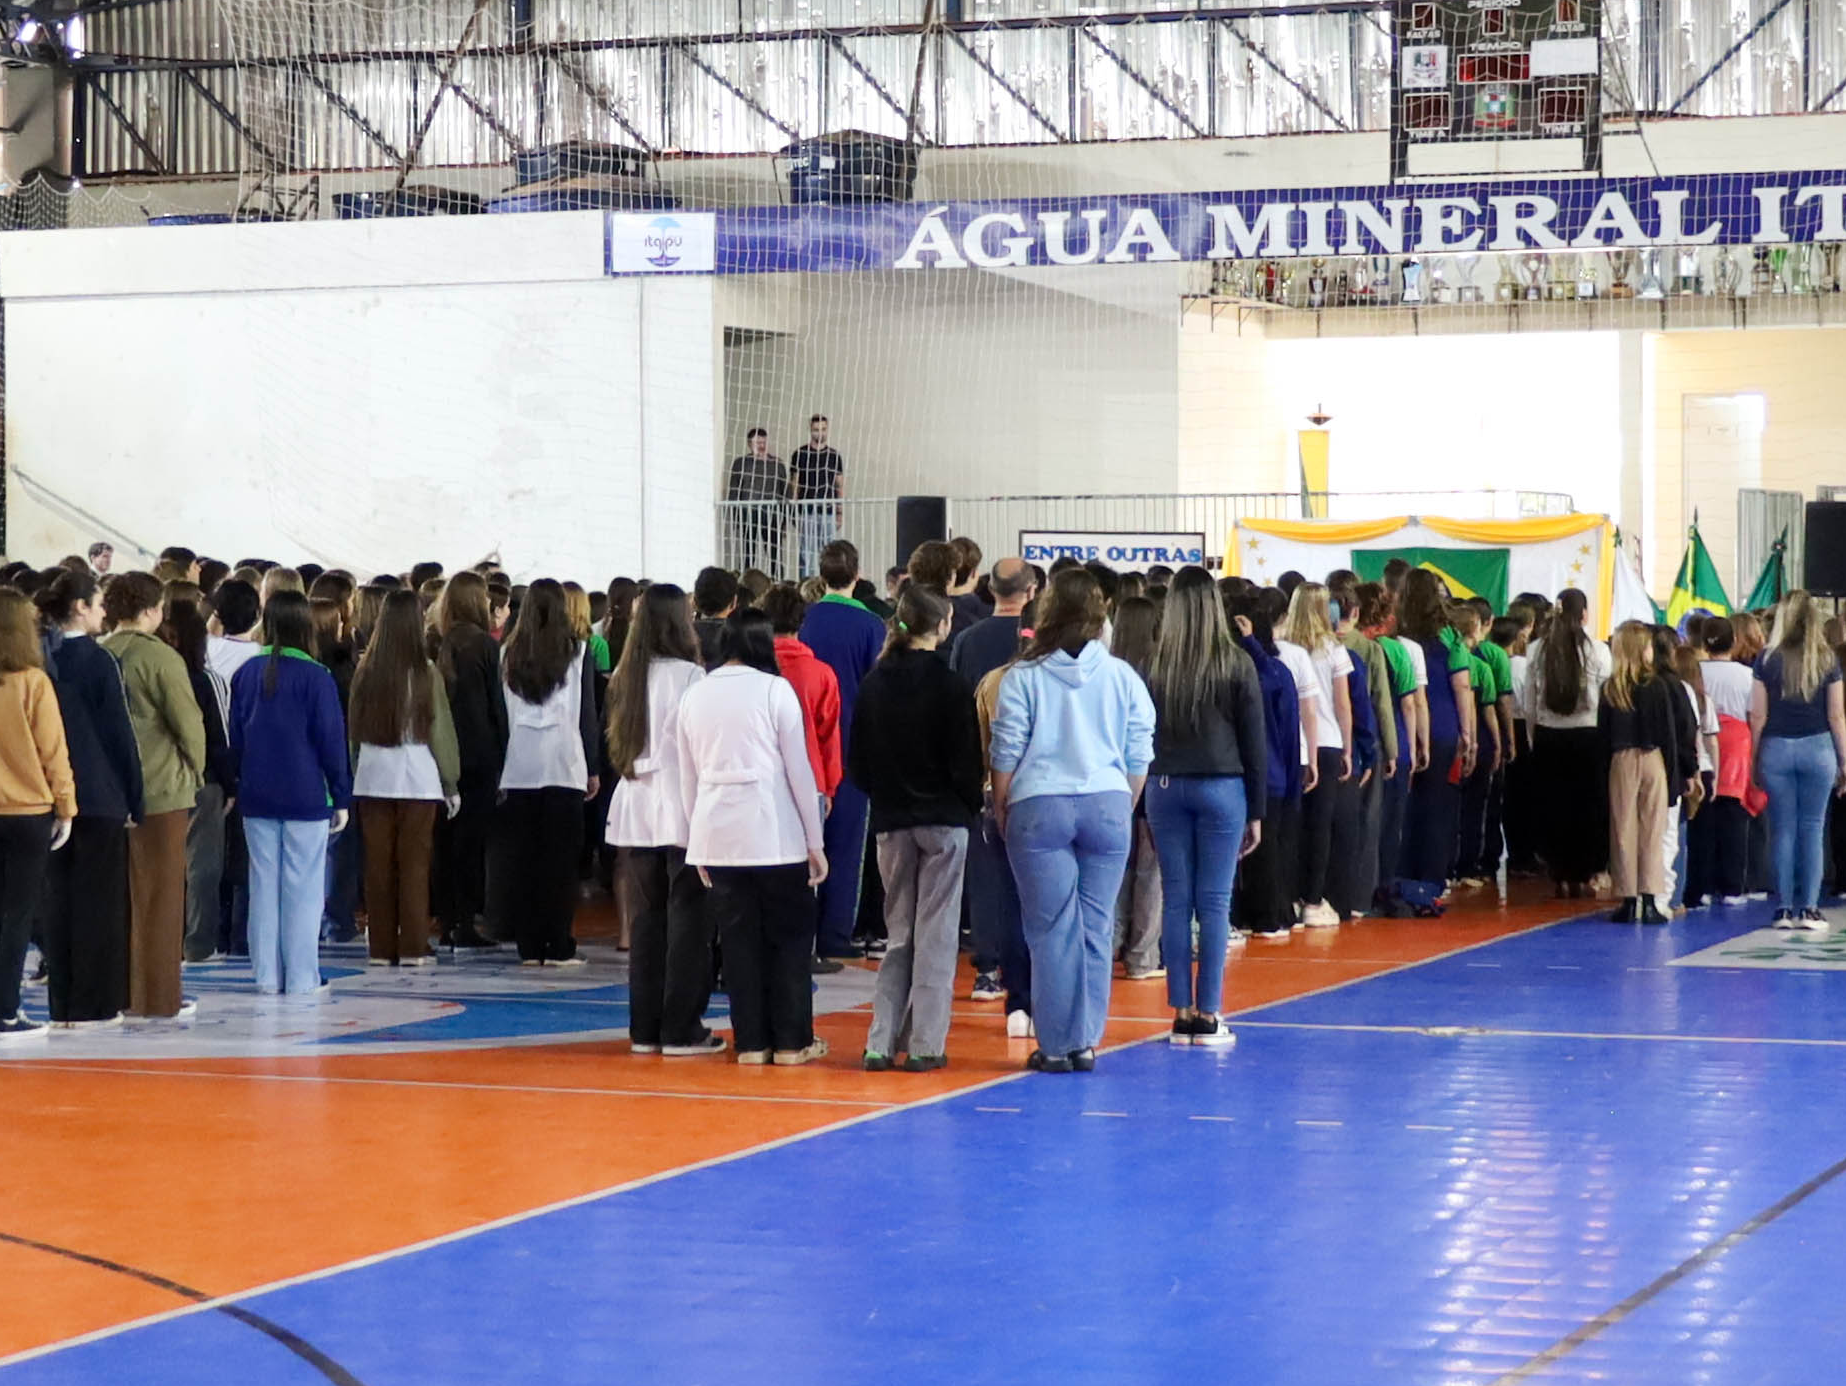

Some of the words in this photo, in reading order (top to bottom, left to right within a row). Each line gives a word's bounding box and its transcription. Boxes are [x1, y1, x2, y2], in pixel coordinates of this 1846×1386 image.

[1469, 41, 1521, 52] TEMPO
[894, 206, 1180, 269] ÁGUA
[1205, 189, 1722, 260] MINERAL
[1024, 545, 1100, 562] ENTRE
[1106, 545, 1203, 563] OUTRAS
